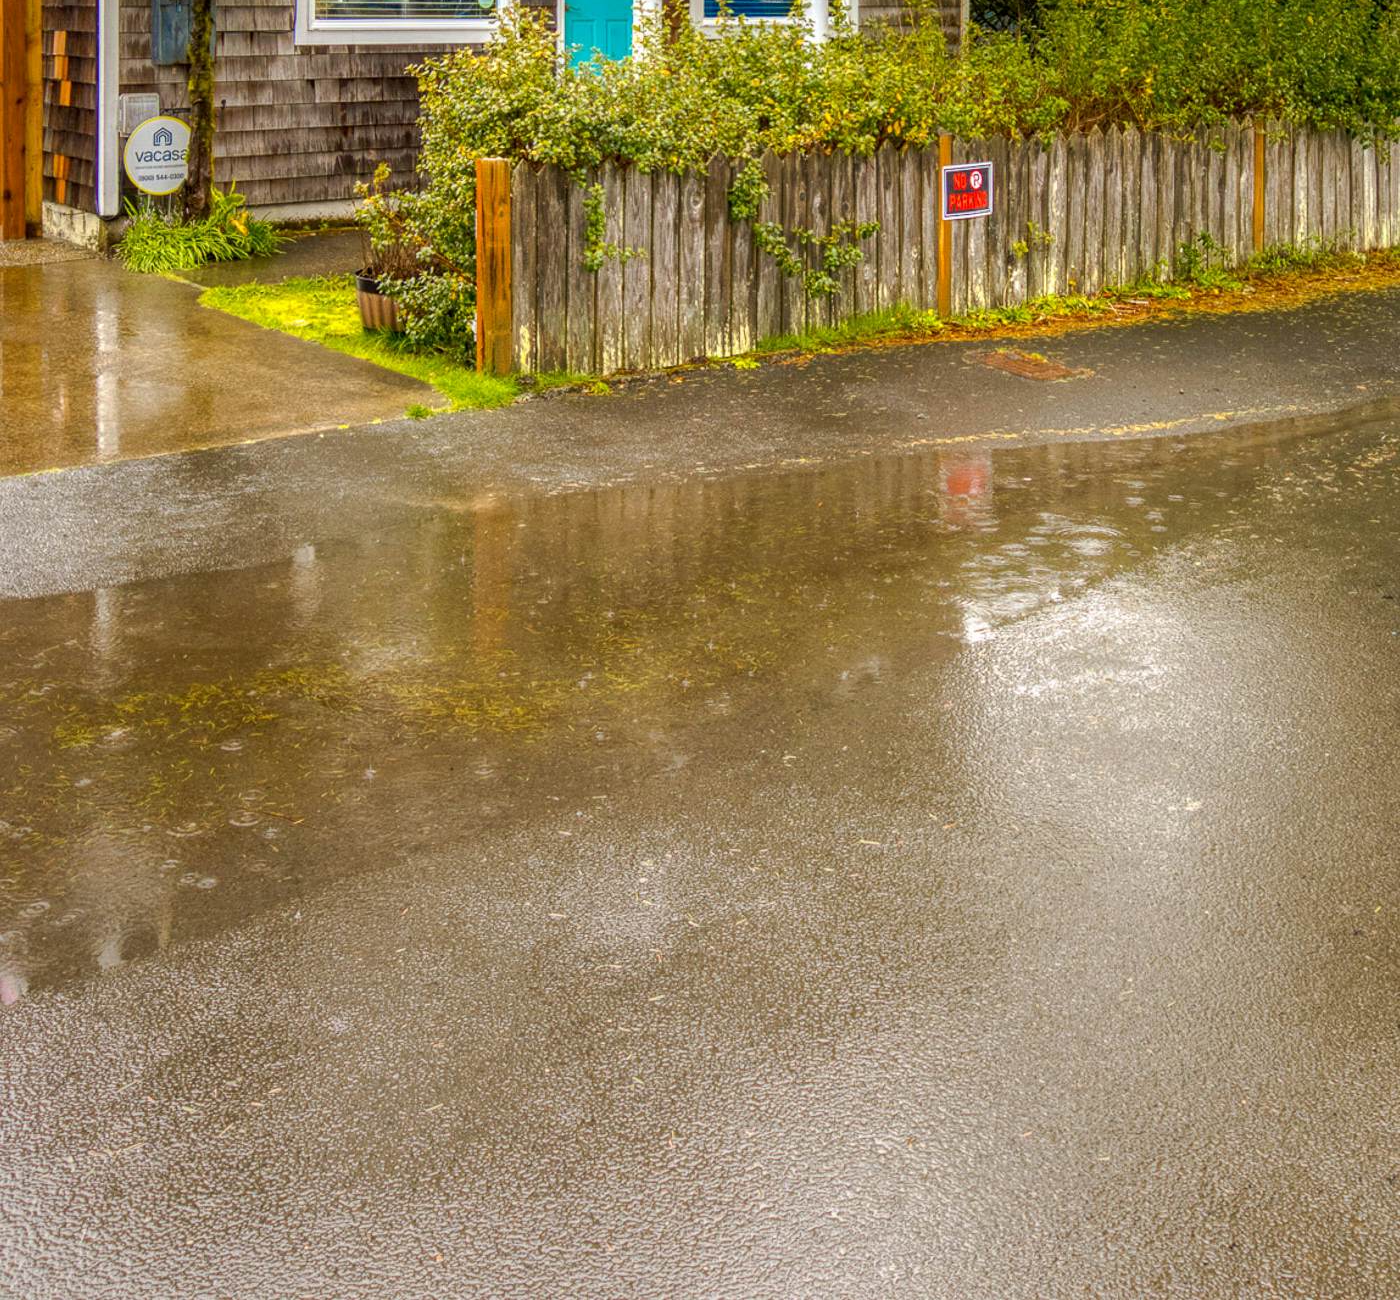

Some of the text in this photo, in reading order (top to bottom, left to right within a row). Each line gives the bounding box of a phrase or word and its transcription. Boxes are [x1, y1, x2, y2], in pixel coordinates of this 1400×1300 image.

[135, 148, 188, 163] vacasa
[953, 171, 967, 190] NO
[949, 189, 988, 213] PARKING
